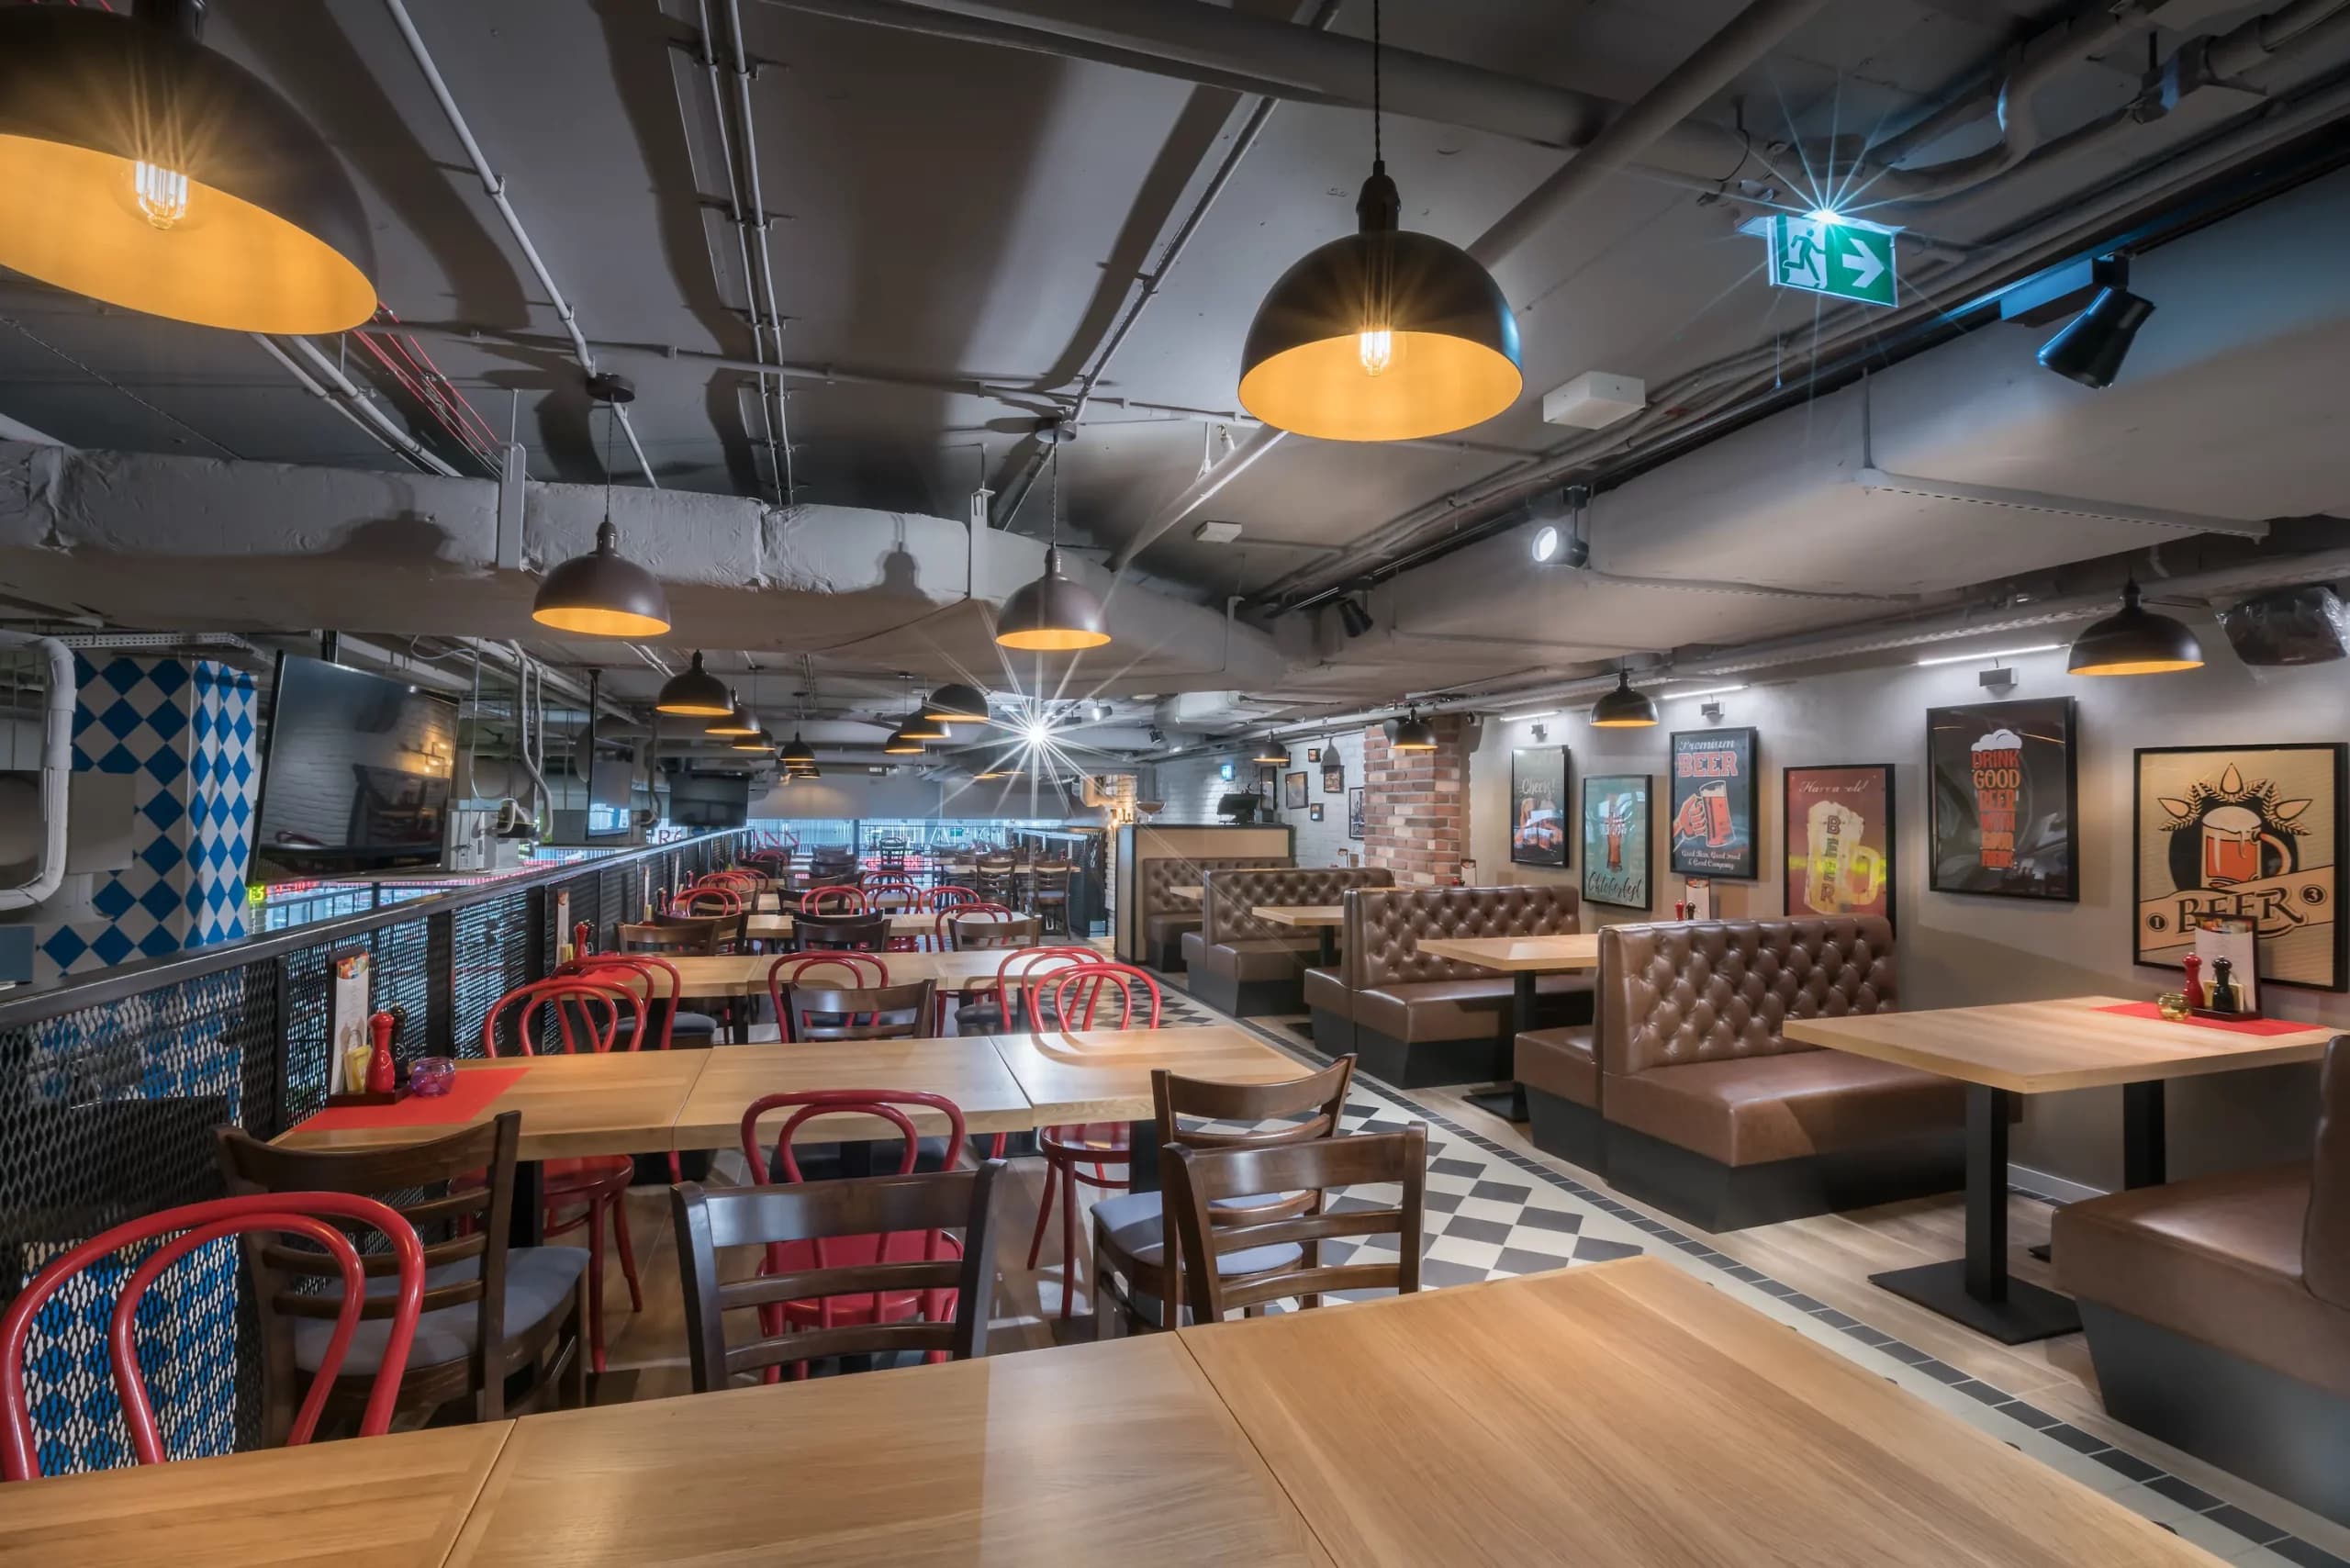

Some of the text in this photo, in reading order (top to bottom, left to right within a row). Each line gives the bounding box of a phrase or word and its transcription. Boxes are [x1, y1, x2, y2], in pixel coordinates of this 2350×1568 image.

[1679, 739, 1734, 750] Premium
[1678, 751, 1739, 778] BEER
[1971, 749, 2020, 769] DRINK
[1973, 769, 2020, 790] GOOD
[1977, 790, 2017, 811] BEER
[1820, 814, 1841, 903] BEER
[1588, 871, 1642, 902] Oktoberfest
[2177, 887, 2305, 934] BEER
